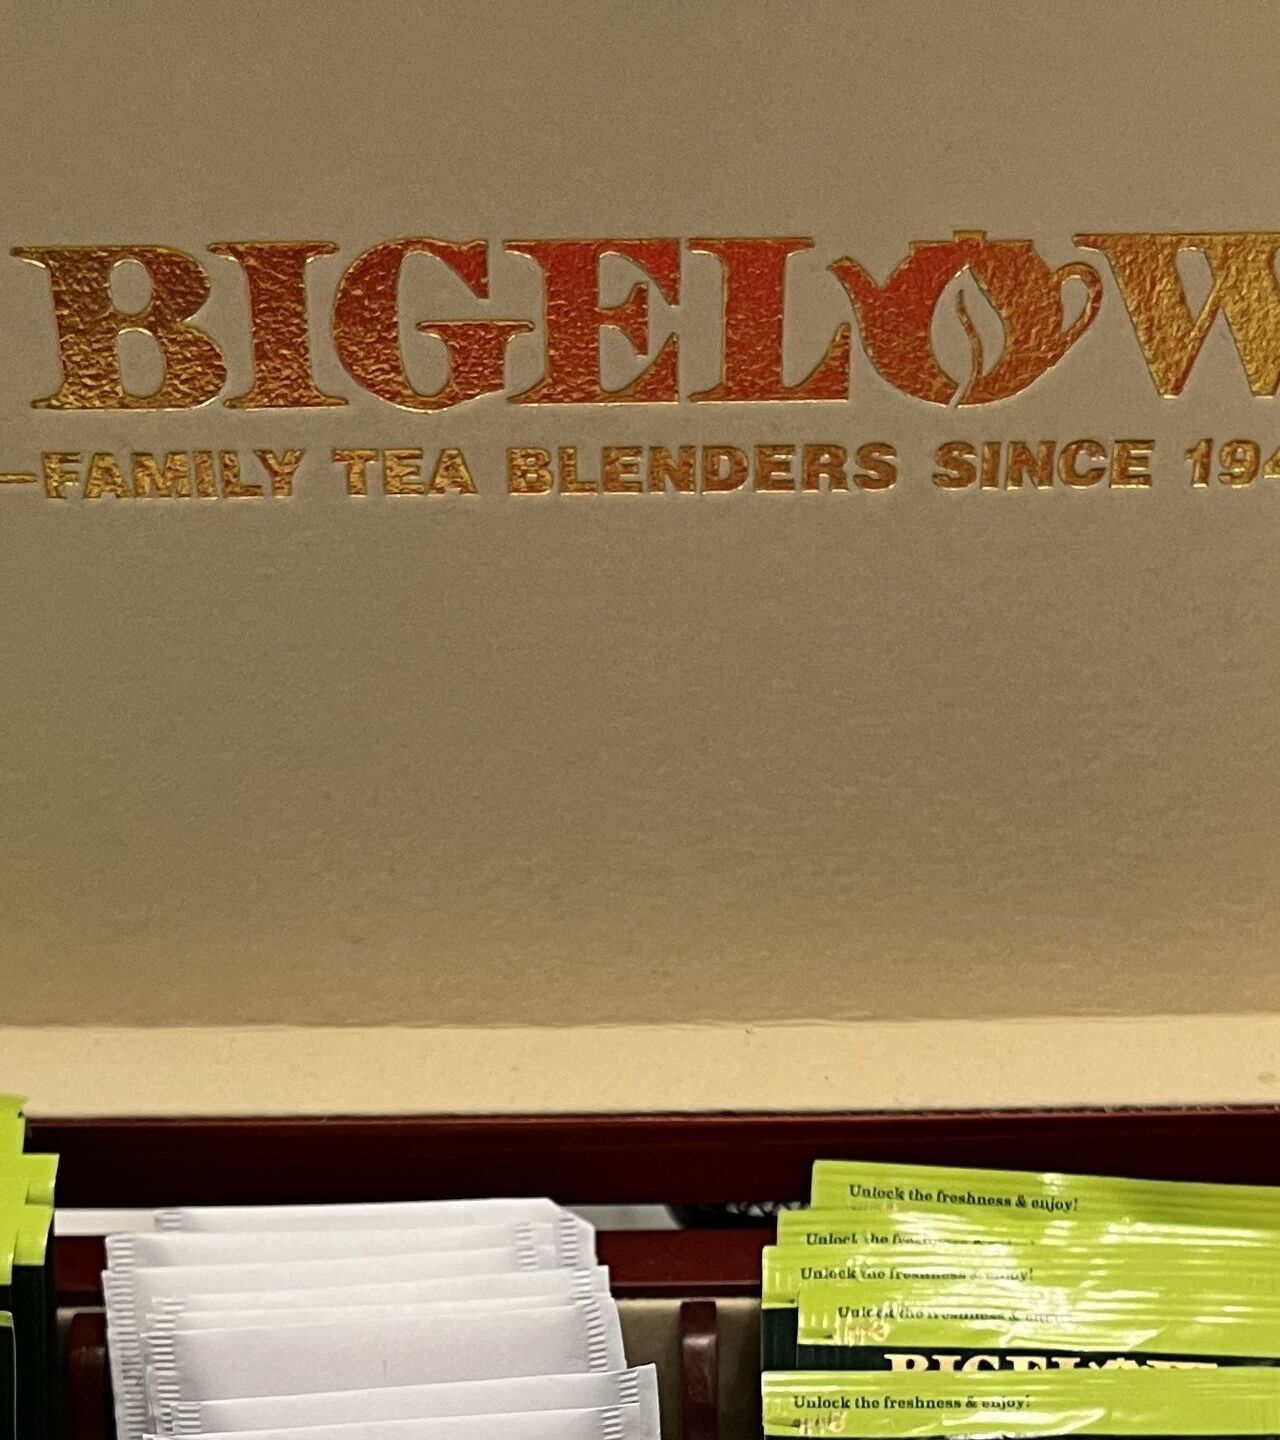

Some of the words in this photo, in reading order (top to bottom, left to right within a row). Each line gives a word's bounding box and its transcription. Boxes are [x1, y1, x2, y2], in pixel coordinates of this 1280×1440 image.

[42, 449, 306, 501] FAMILY
[333, 446, 478, 498] TEA
[506, 442, 898, 497] BLENDERS
[932, 439, 1152, 489] SINCE
[849, 1184, 904, 1200] Unlock
[909, 1187, 933, 1201] the
[937, 1190, 1011, 1207] freshness
[1015, 1194, 1027, 1207] &
[1031, 1197, 1078, 1212] enjoy!
[794, 1396, 850, 1409] Unlock
[855, 1396, 879, 1408] the
[884, 1396, 961, 1408] freshness
